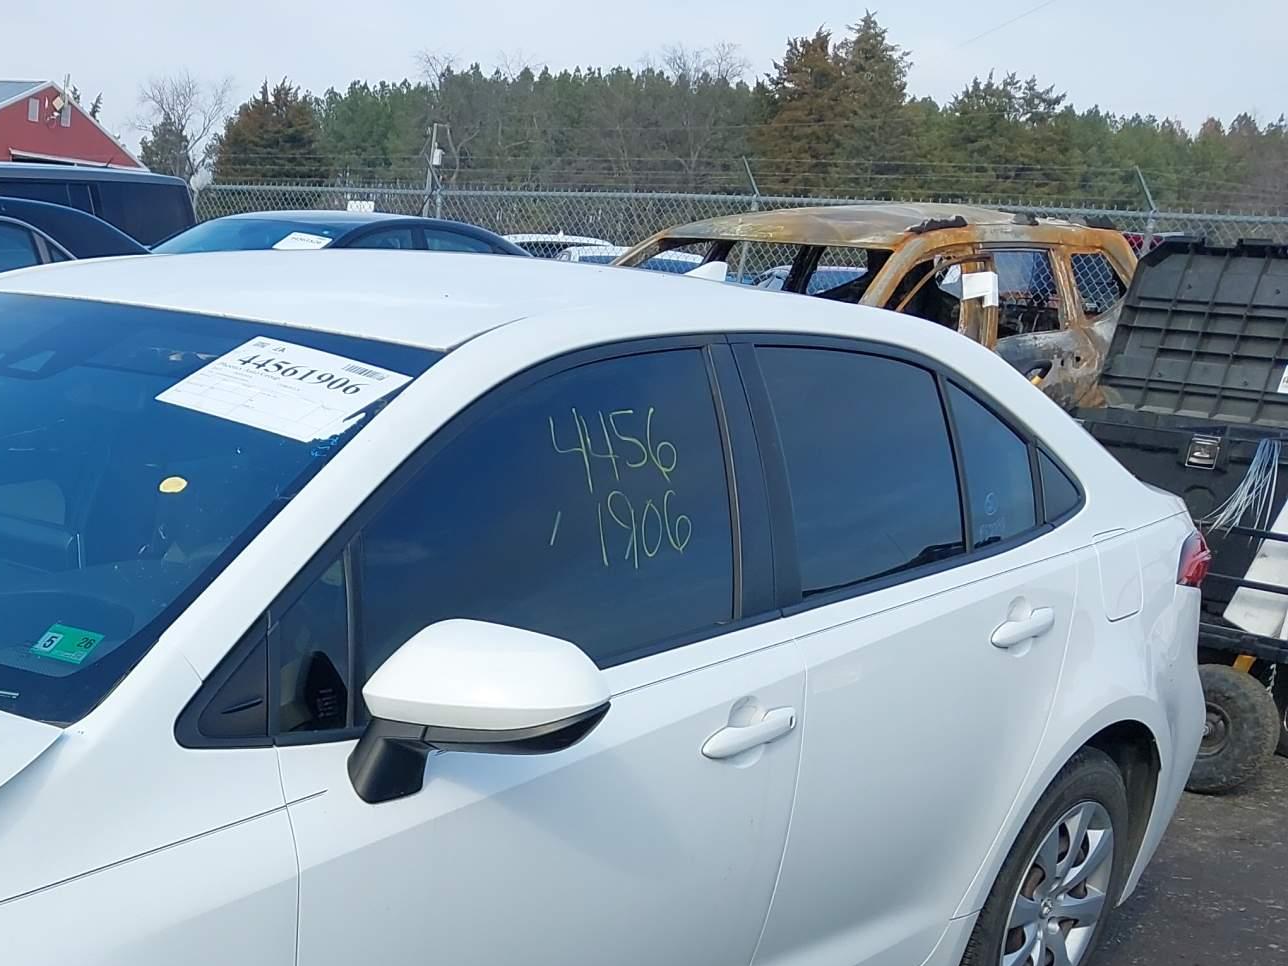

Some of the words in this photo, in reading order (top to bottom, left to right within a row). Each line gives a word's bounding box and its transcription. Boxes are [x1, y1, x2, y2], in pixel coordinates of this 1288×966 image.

[238, 354, 369, 395] 44561906
[548, 407, 677, 494] 4456
[597, 489, 692, 569] 1906
[42, 635, 58, 649] 5
[76, 637, 96, 649] 26
